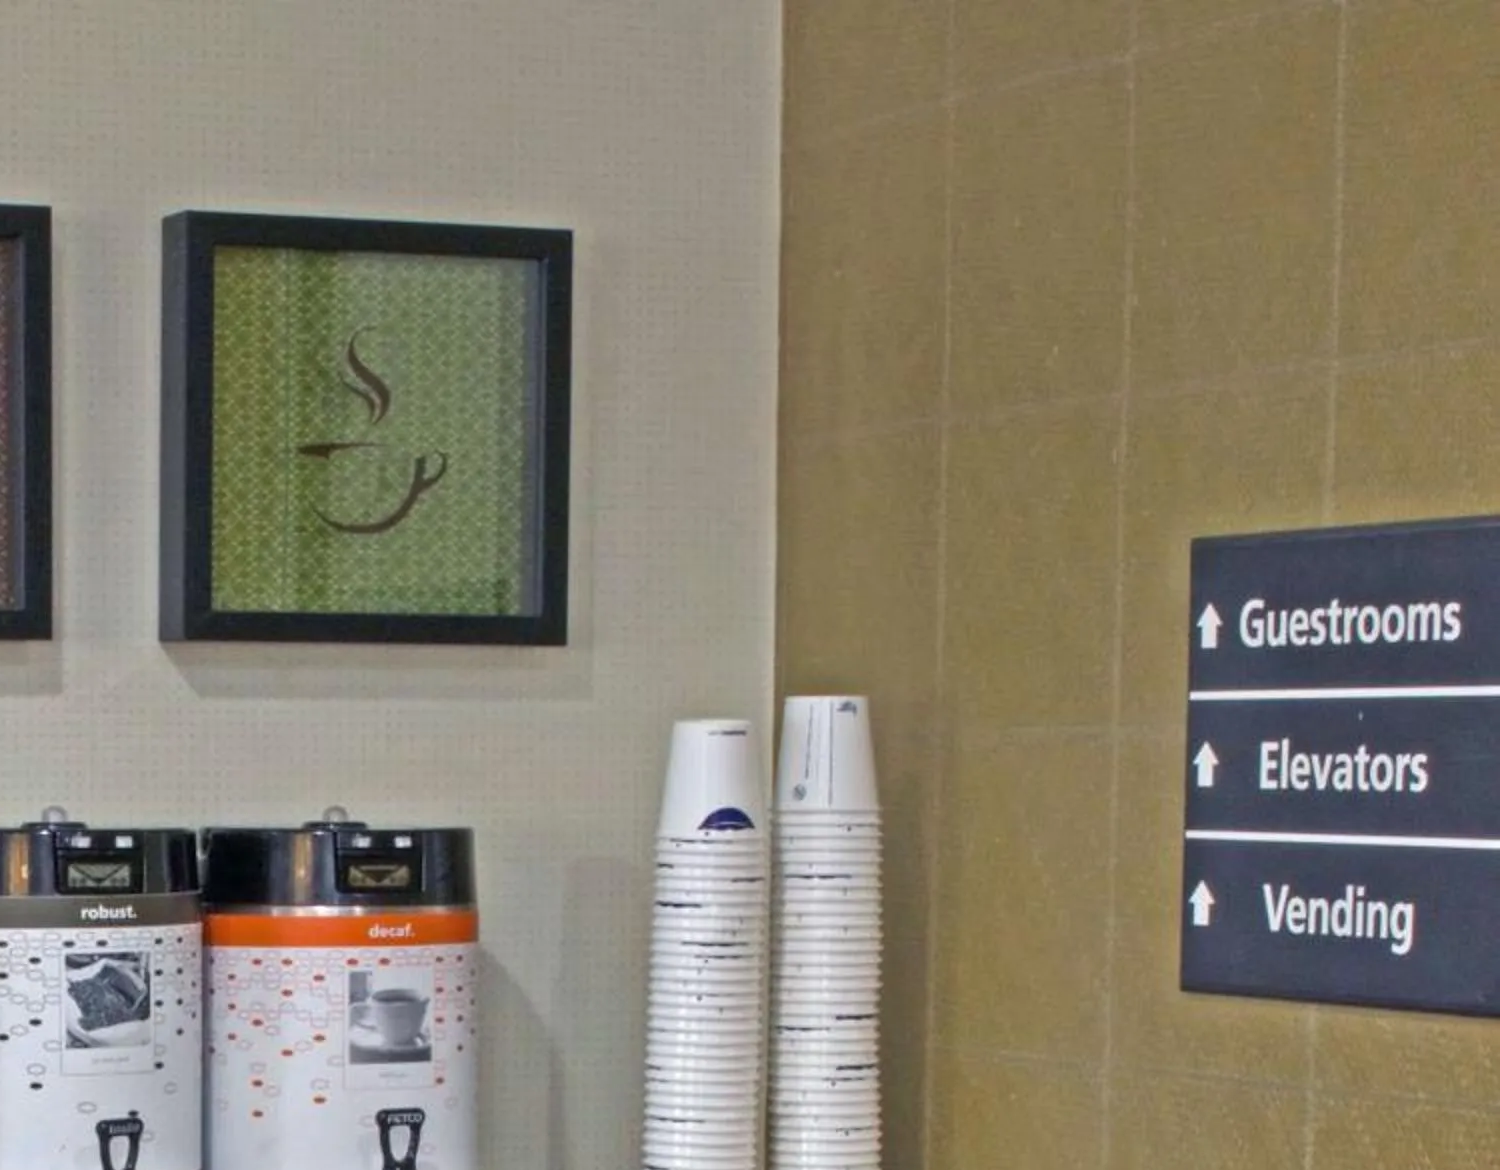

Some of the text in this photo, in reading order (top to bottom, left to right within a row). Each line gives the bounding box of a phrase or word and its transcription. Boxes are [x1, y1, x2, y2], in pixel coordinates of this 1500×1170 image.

[1239, 598, 1462, 648] Guestrooms
[1258, 737, 1429, 793] Elevators
[80, 903, 138, 921] robust.
[368, 923, 416, 938] decaf.
[1262, 883, 1415, 956] Vending
